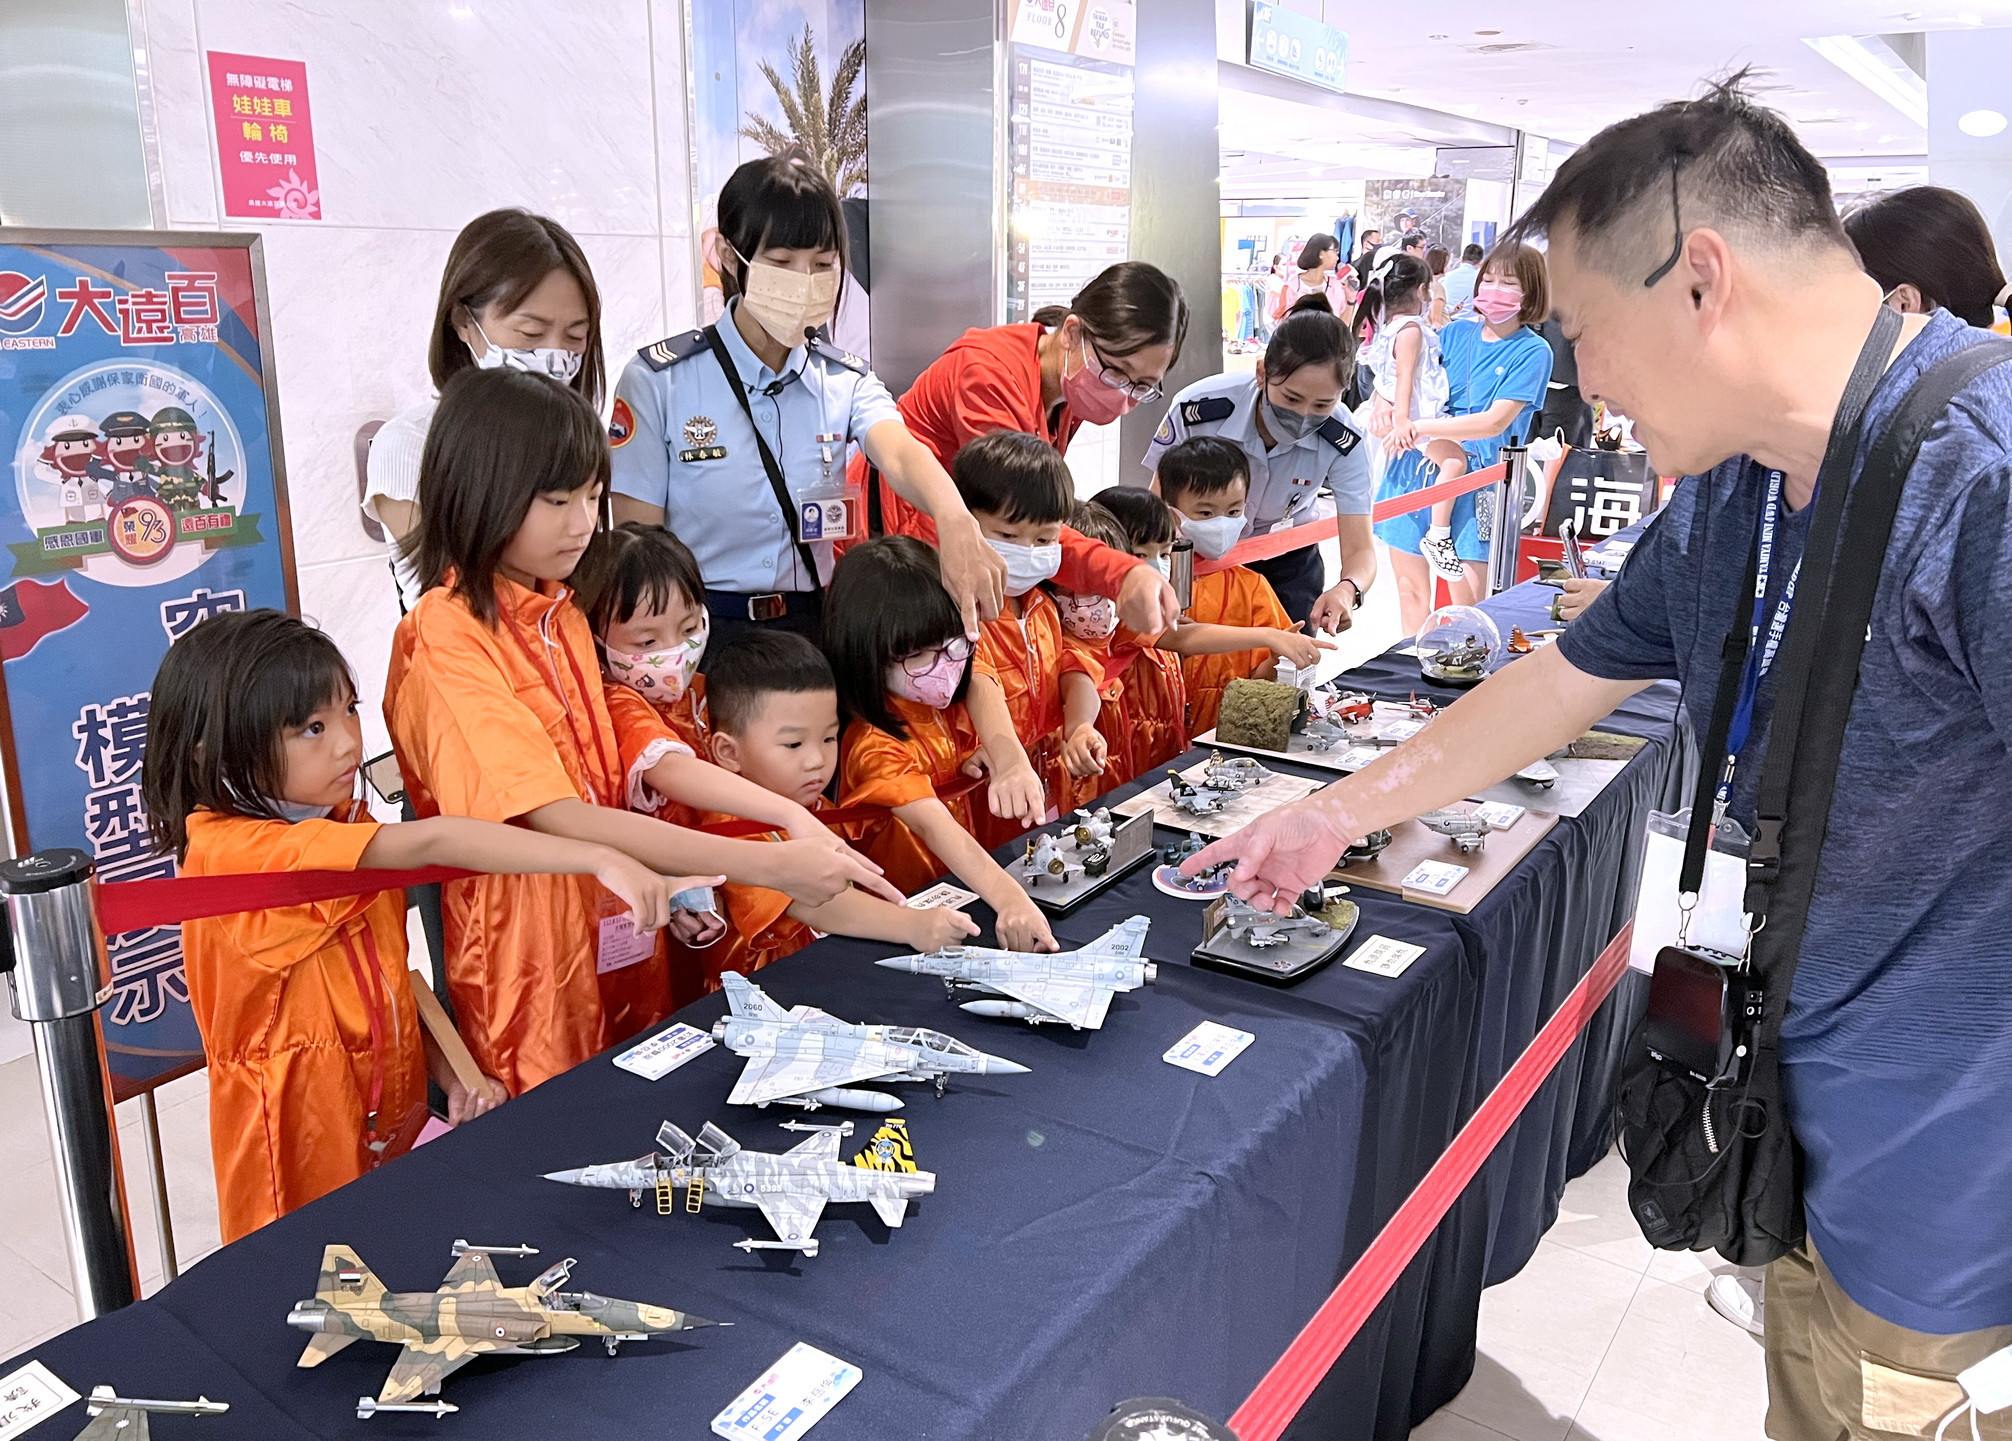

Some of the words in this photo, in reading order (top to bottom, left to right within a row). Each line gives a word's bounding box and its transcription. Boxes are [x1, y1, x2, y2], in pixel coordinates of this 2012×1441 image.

[1055, 4, 1067, 39] 8
[226, 72, 294, 93] 無障礙電梯
[232, 94, 293, 118] 娃娃車
[239, 150, 298, 166] 優先使用
[57, 272, 219, 346] 大遠百
[3, 337, 55, 349] EASTERN
[178, 326, 219, 343] 高雄
[1766, 471, 1781, 502] WORLD
[1570, 476, 1644, 536] 海
[1110, 943, 1130, 951] 2002
[751, 1407, 780, 1432] F-5E
